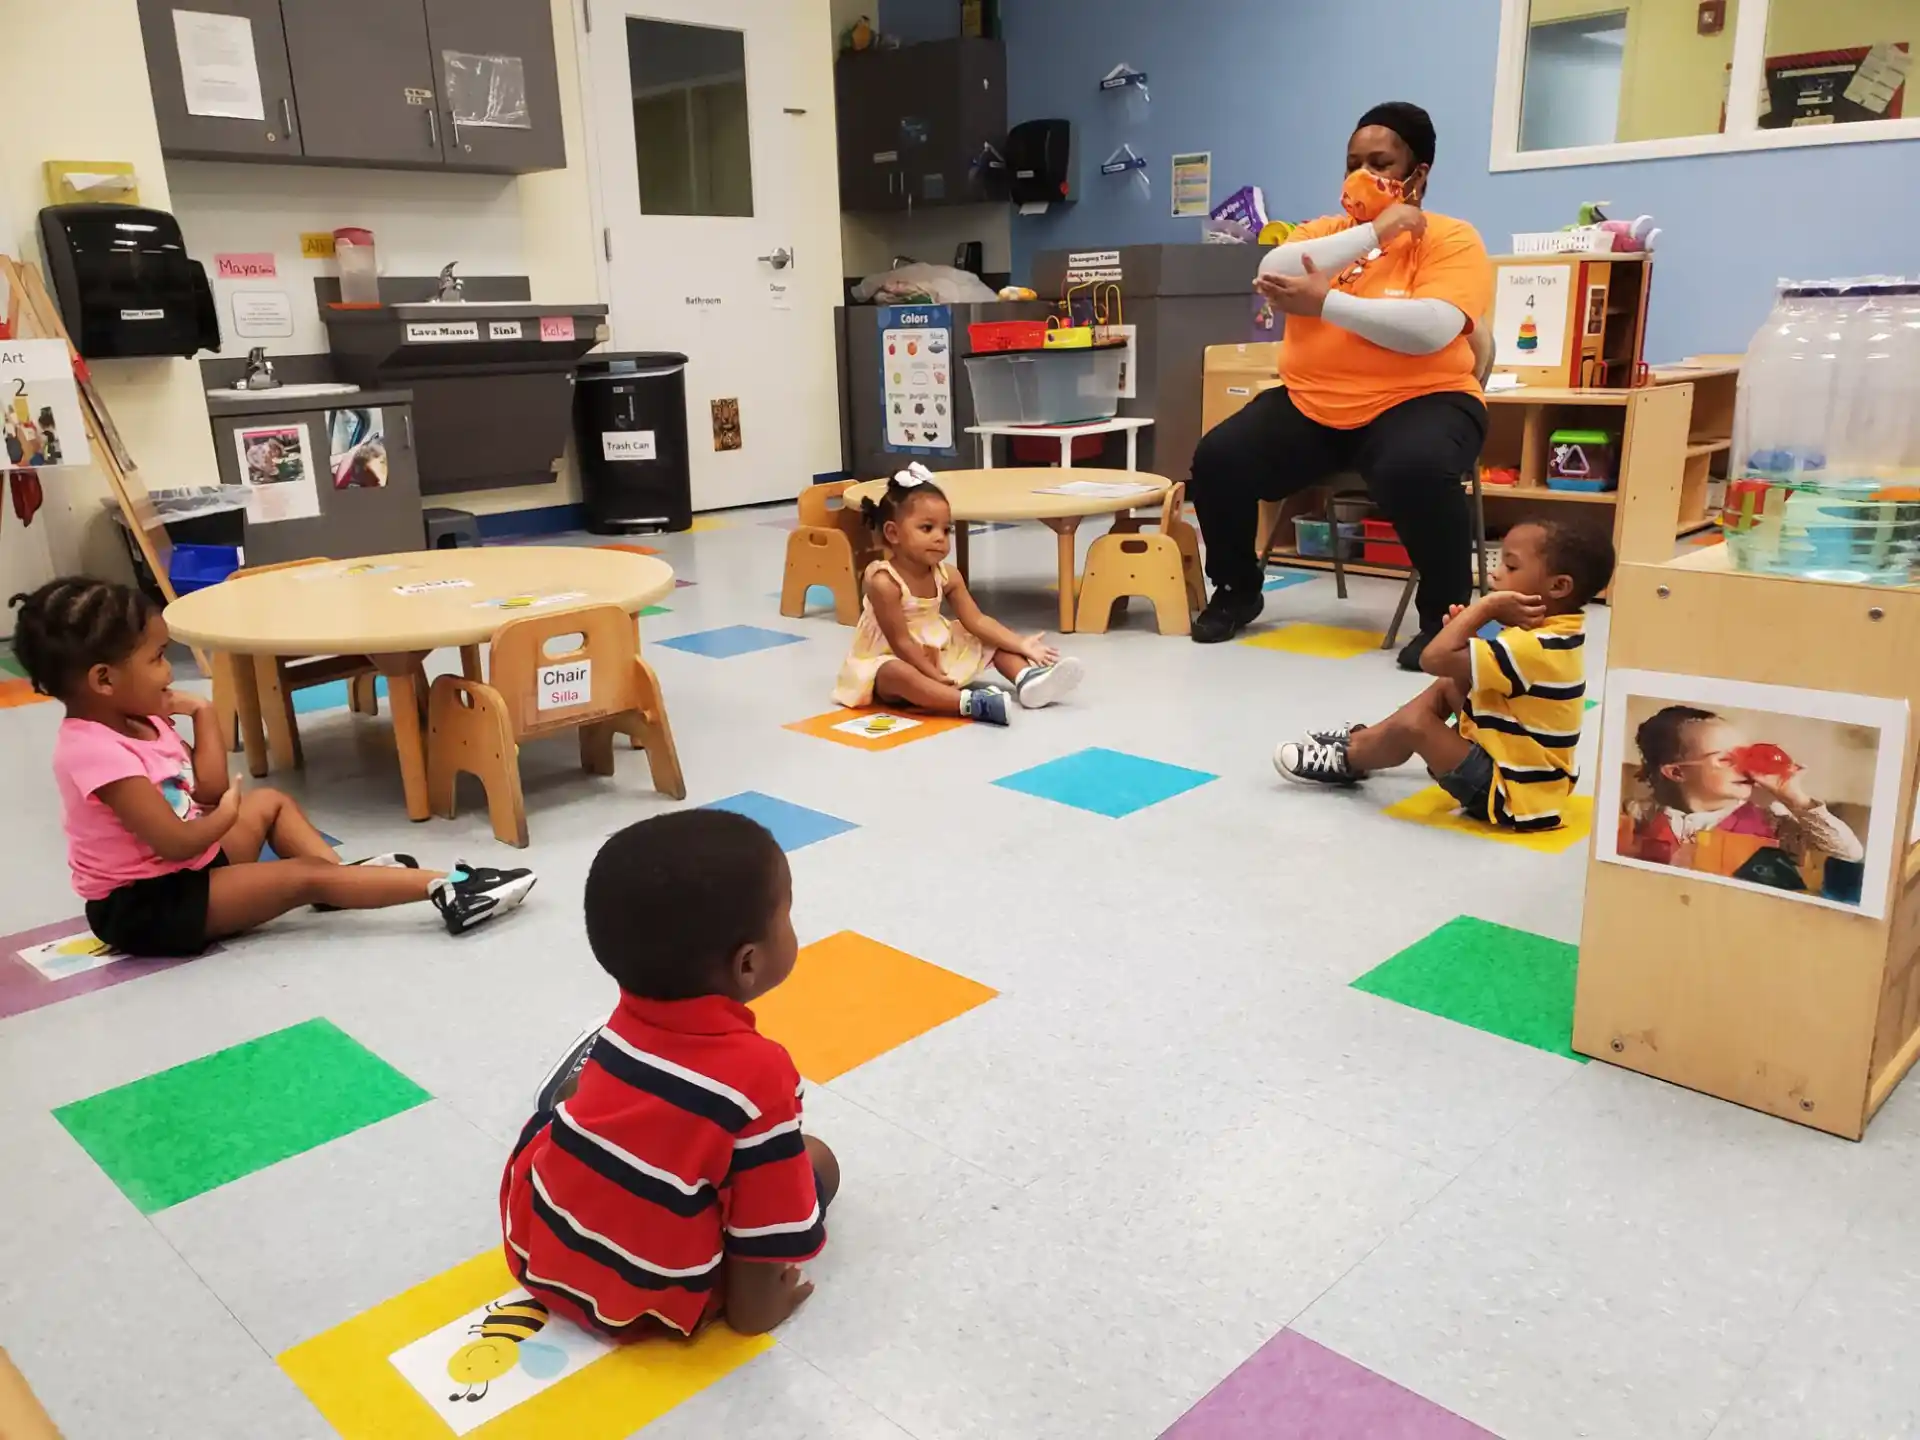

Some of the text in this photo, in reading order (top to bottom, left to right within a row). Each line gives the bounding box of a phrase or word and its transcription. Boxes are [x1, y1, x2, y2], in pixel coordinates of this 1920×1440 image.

[218, 259, 258, 276] Maya
[1509, 275, 1557, 286] Table Toys
[685, 296, 722, 304] Bathroom
[1525, 294, 1535, 309] 4
[901, 313, 929, 324] Colors
[411, 327, 475, 336] Lava Manos
[493, 326, 517, 335] Sink
[2, 352, 26, 363] Art
[12, 378, 29, 397] 2
[606, 441, 650, 450] Trash Can
[543, 667, 588, 686] Chair
[551, 689, 579, 703] Silla
